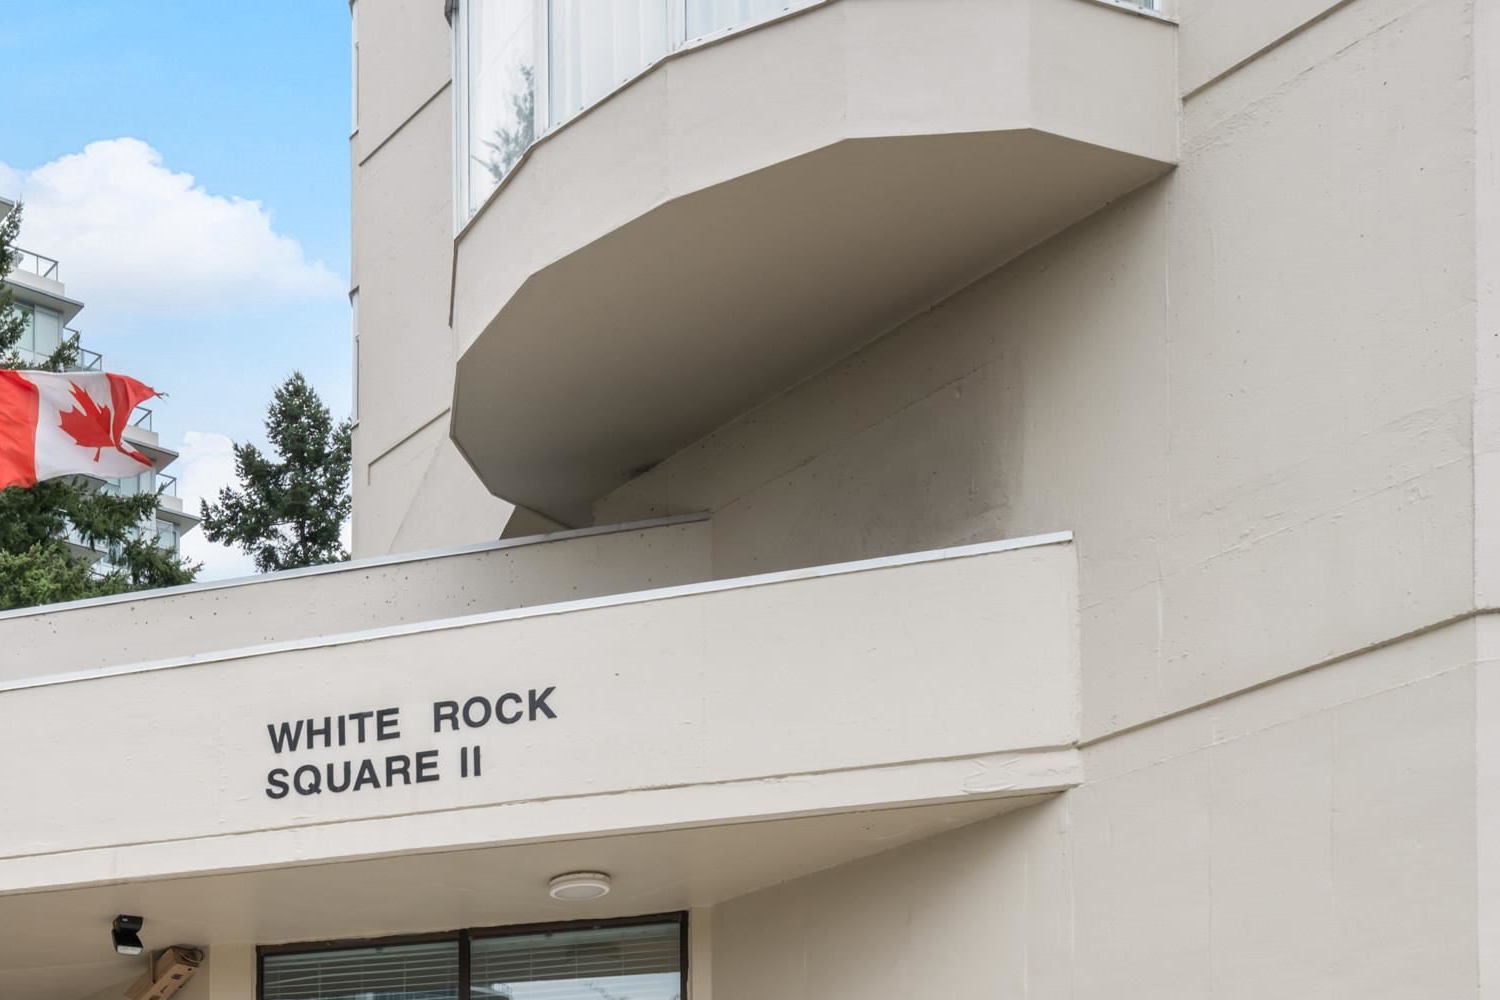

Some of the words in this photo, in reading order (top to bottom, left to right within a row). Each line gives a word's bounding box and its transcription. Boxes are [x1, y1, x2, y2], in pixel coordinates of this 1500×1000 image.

[267, 707, 401, 754] WHITE
[433, 686, 558, 733] ROCK
[265, 749, 440, 800] SQUARE
[460, 745, 482, 778] II
